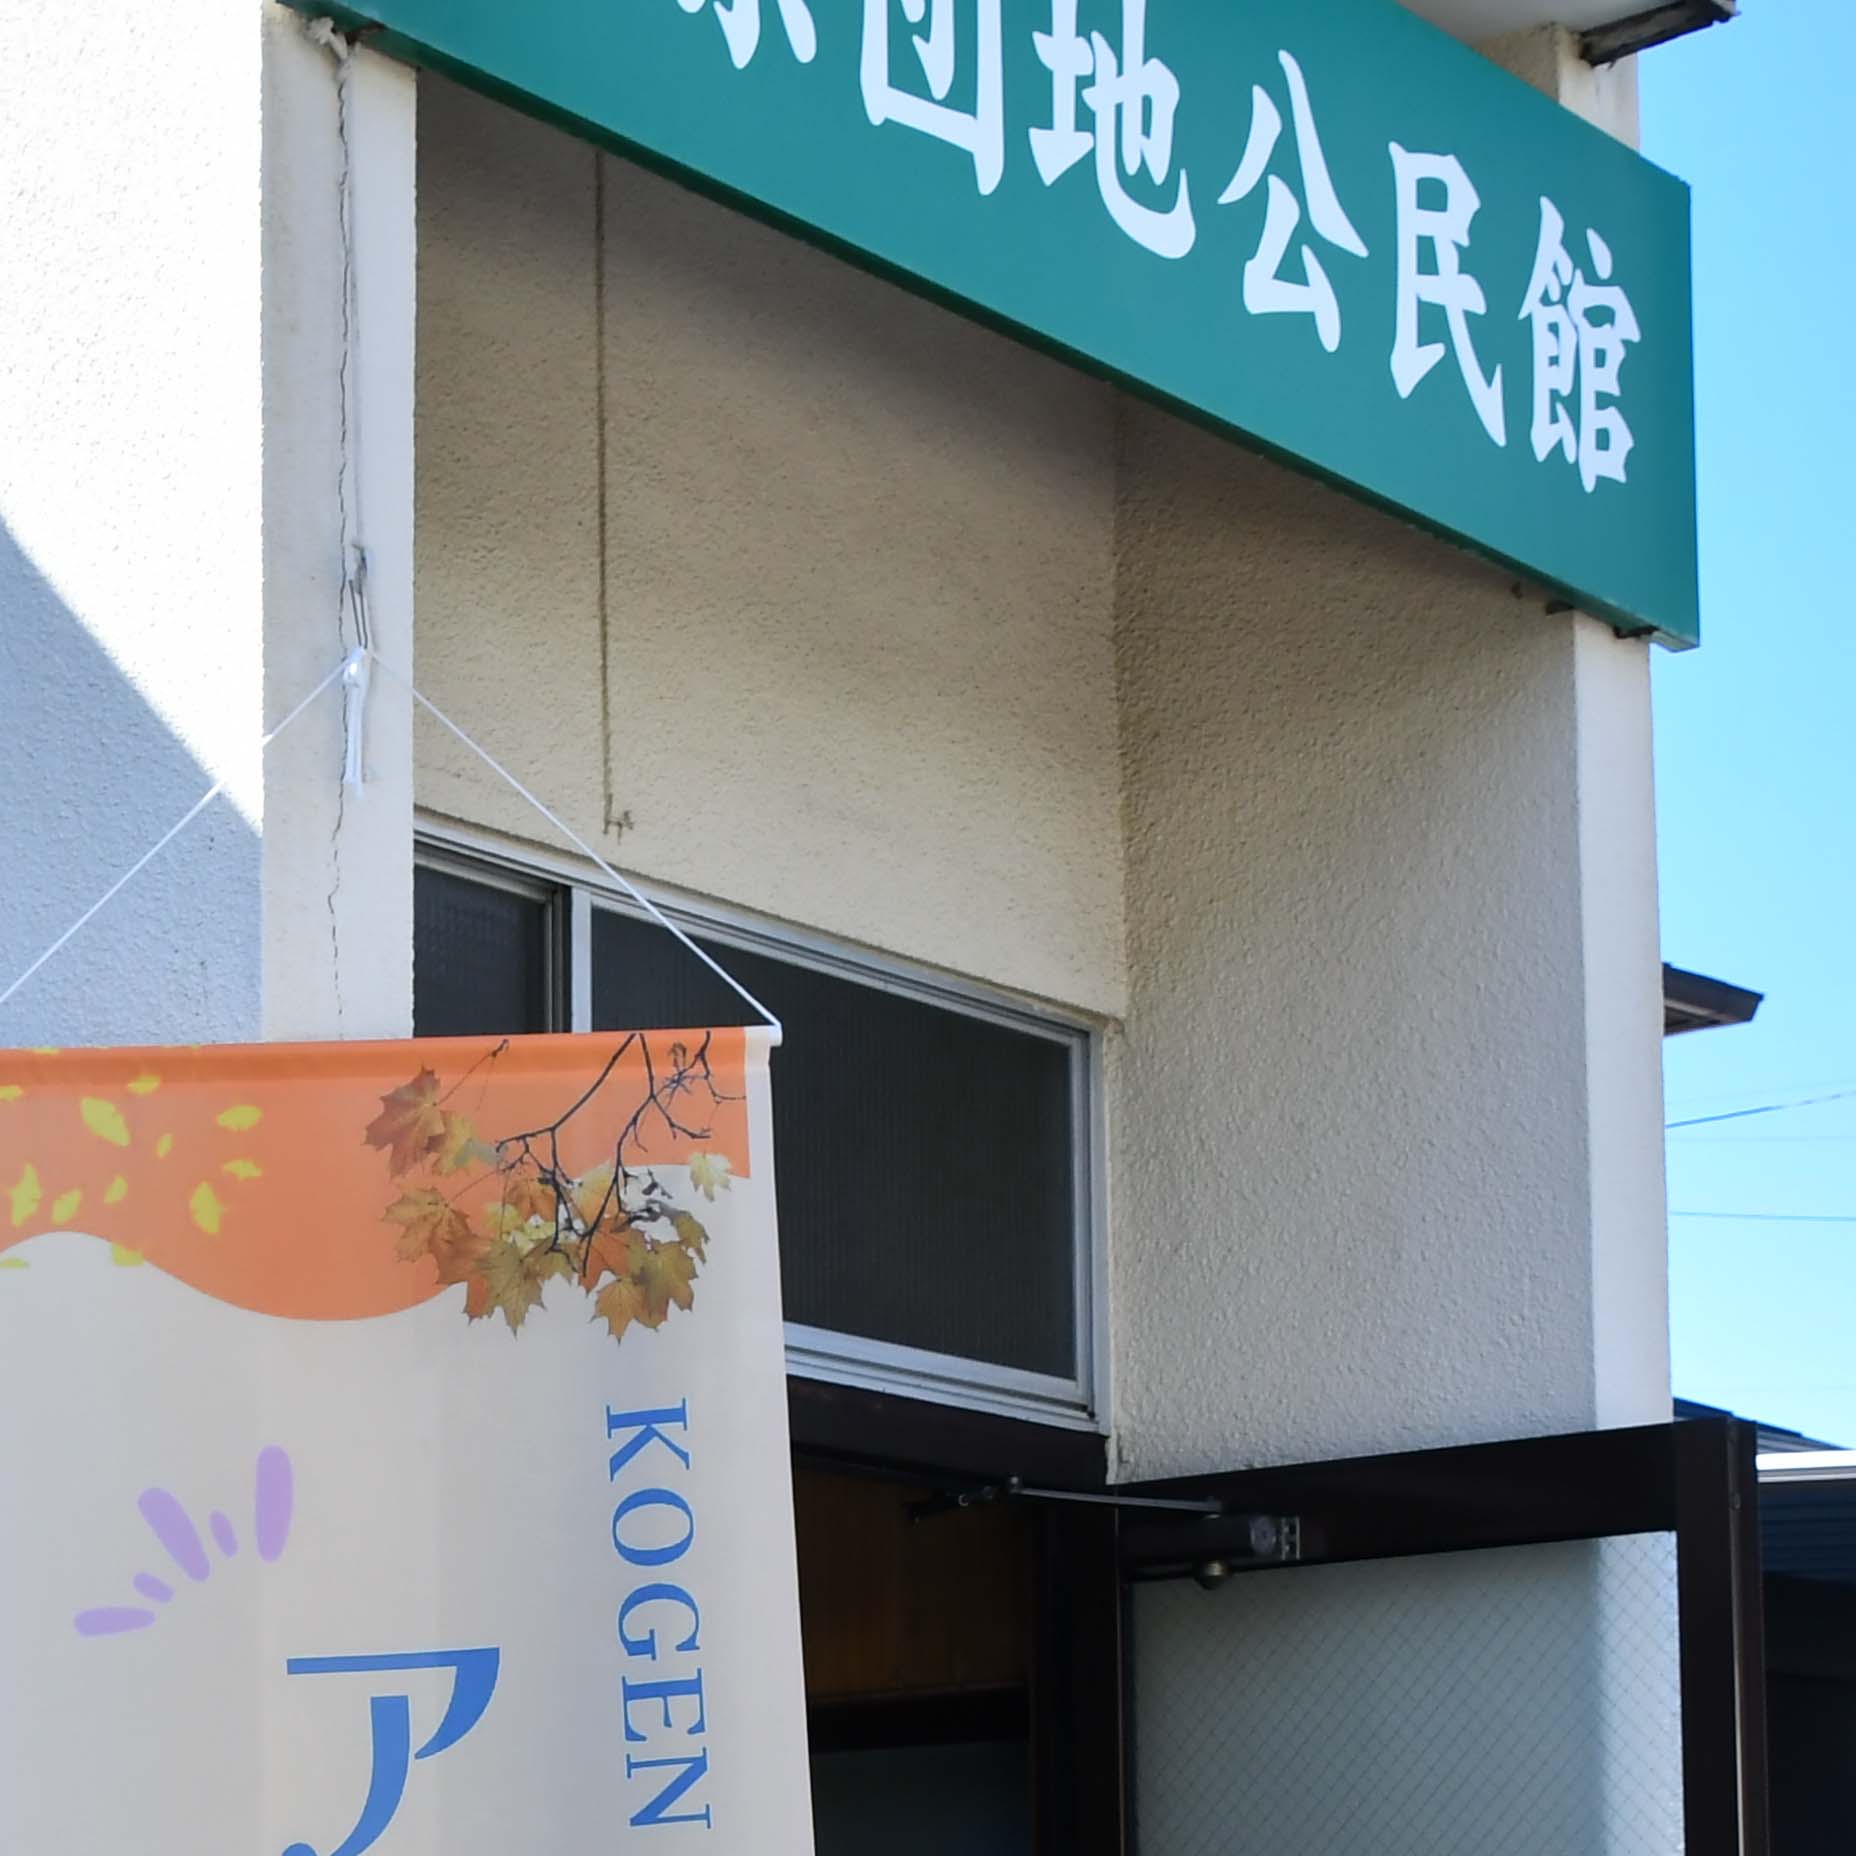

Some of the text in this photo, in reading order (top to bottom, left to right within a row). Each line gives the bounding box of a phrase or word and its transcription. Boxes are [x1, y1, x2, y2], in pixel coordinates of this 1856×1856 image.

[677, 0, 1641, 491] 団地公民館
